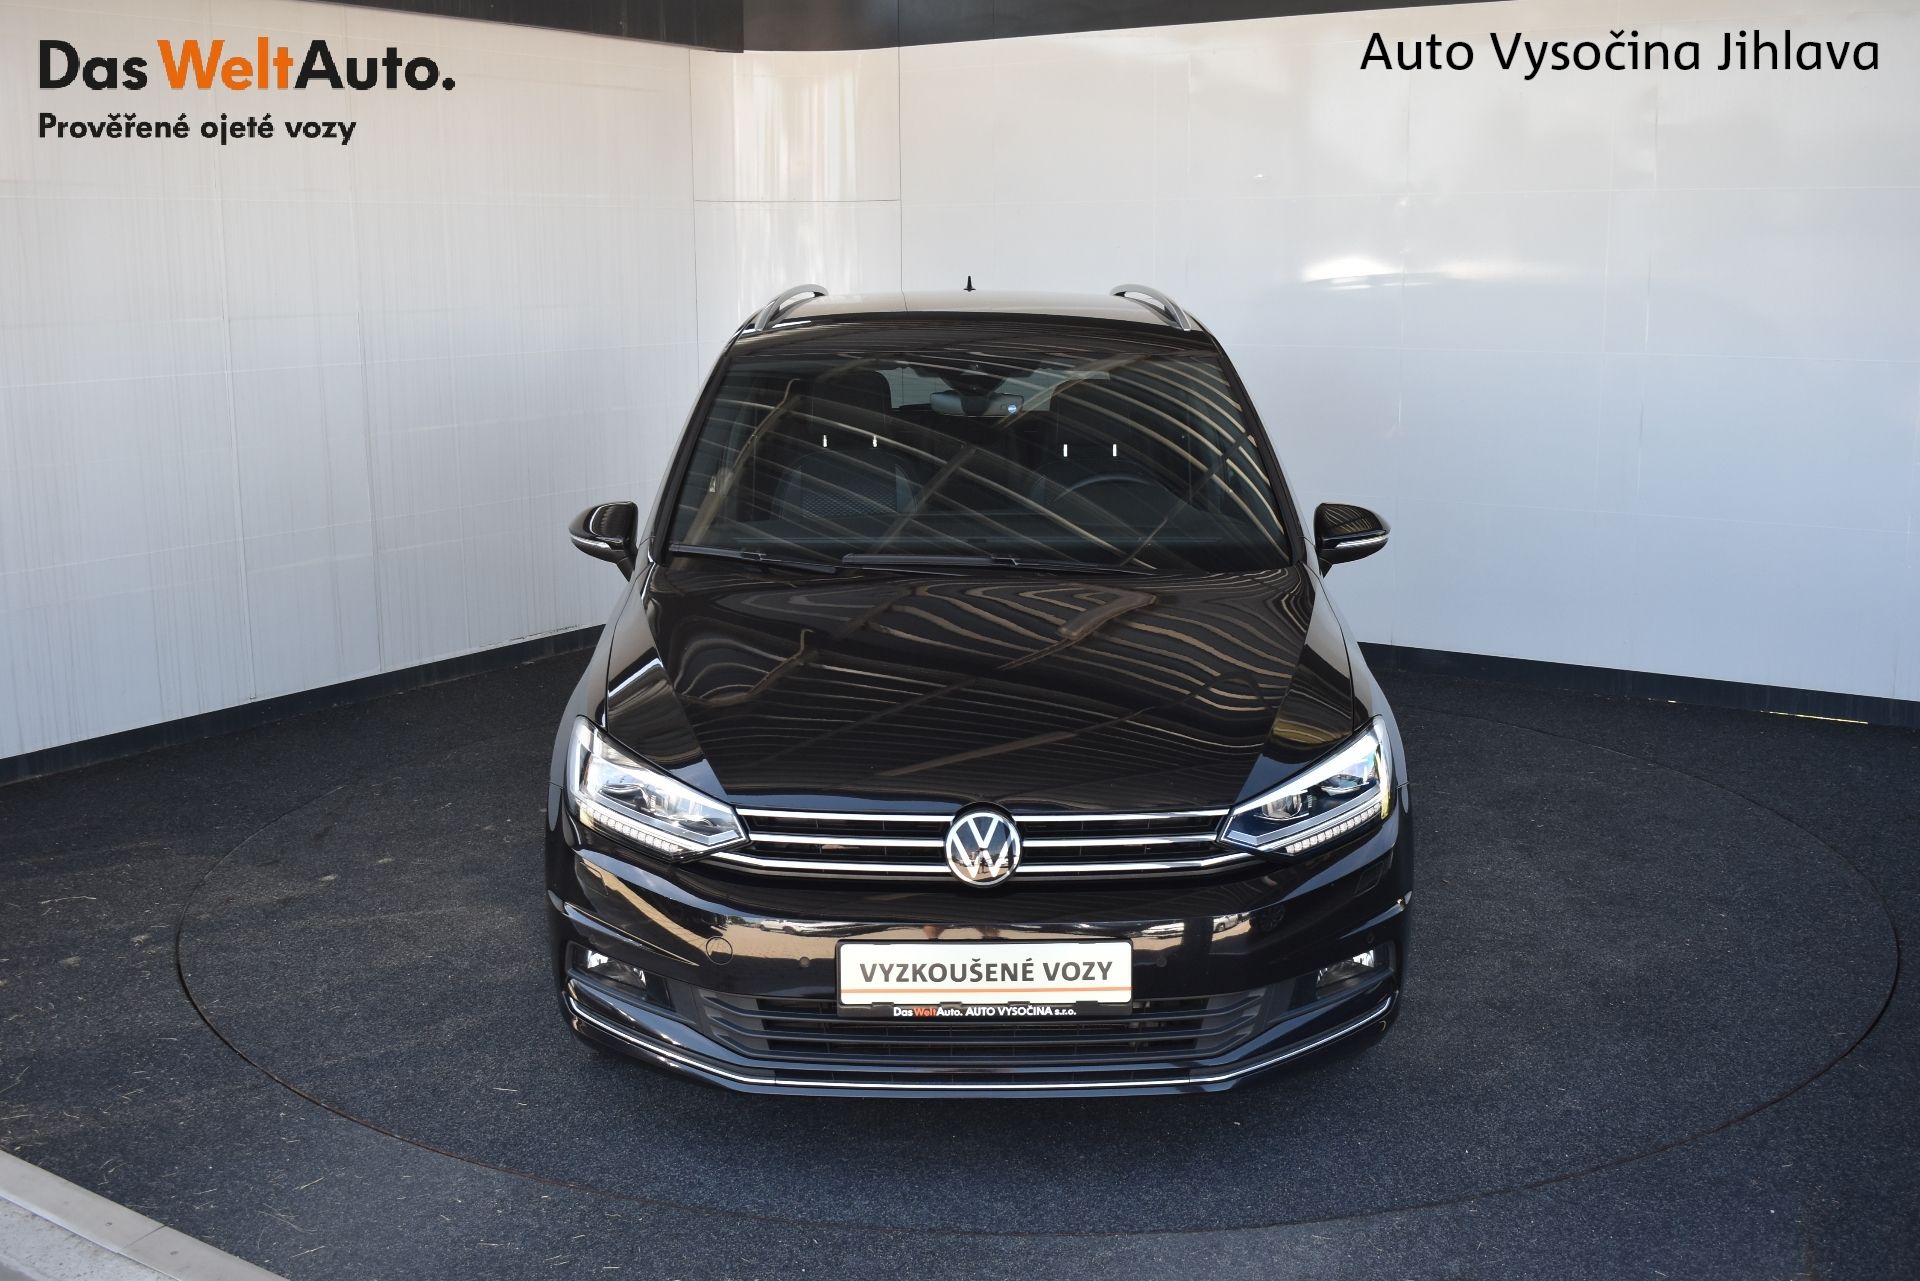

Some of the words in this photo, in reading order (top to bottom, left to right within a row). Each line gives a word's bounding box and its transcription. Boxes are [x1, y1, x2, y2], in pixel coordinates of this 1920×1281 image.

[859, 958, 1034, 984] VYZKOUŠENÉ
[1042, 961, 1113, 982] VOZY
[893, 1007, 913, 1017] Das
[965, 1006, 996, 1016] AUTO
[998, 1004, 1053, 1016] VYSOČINA
